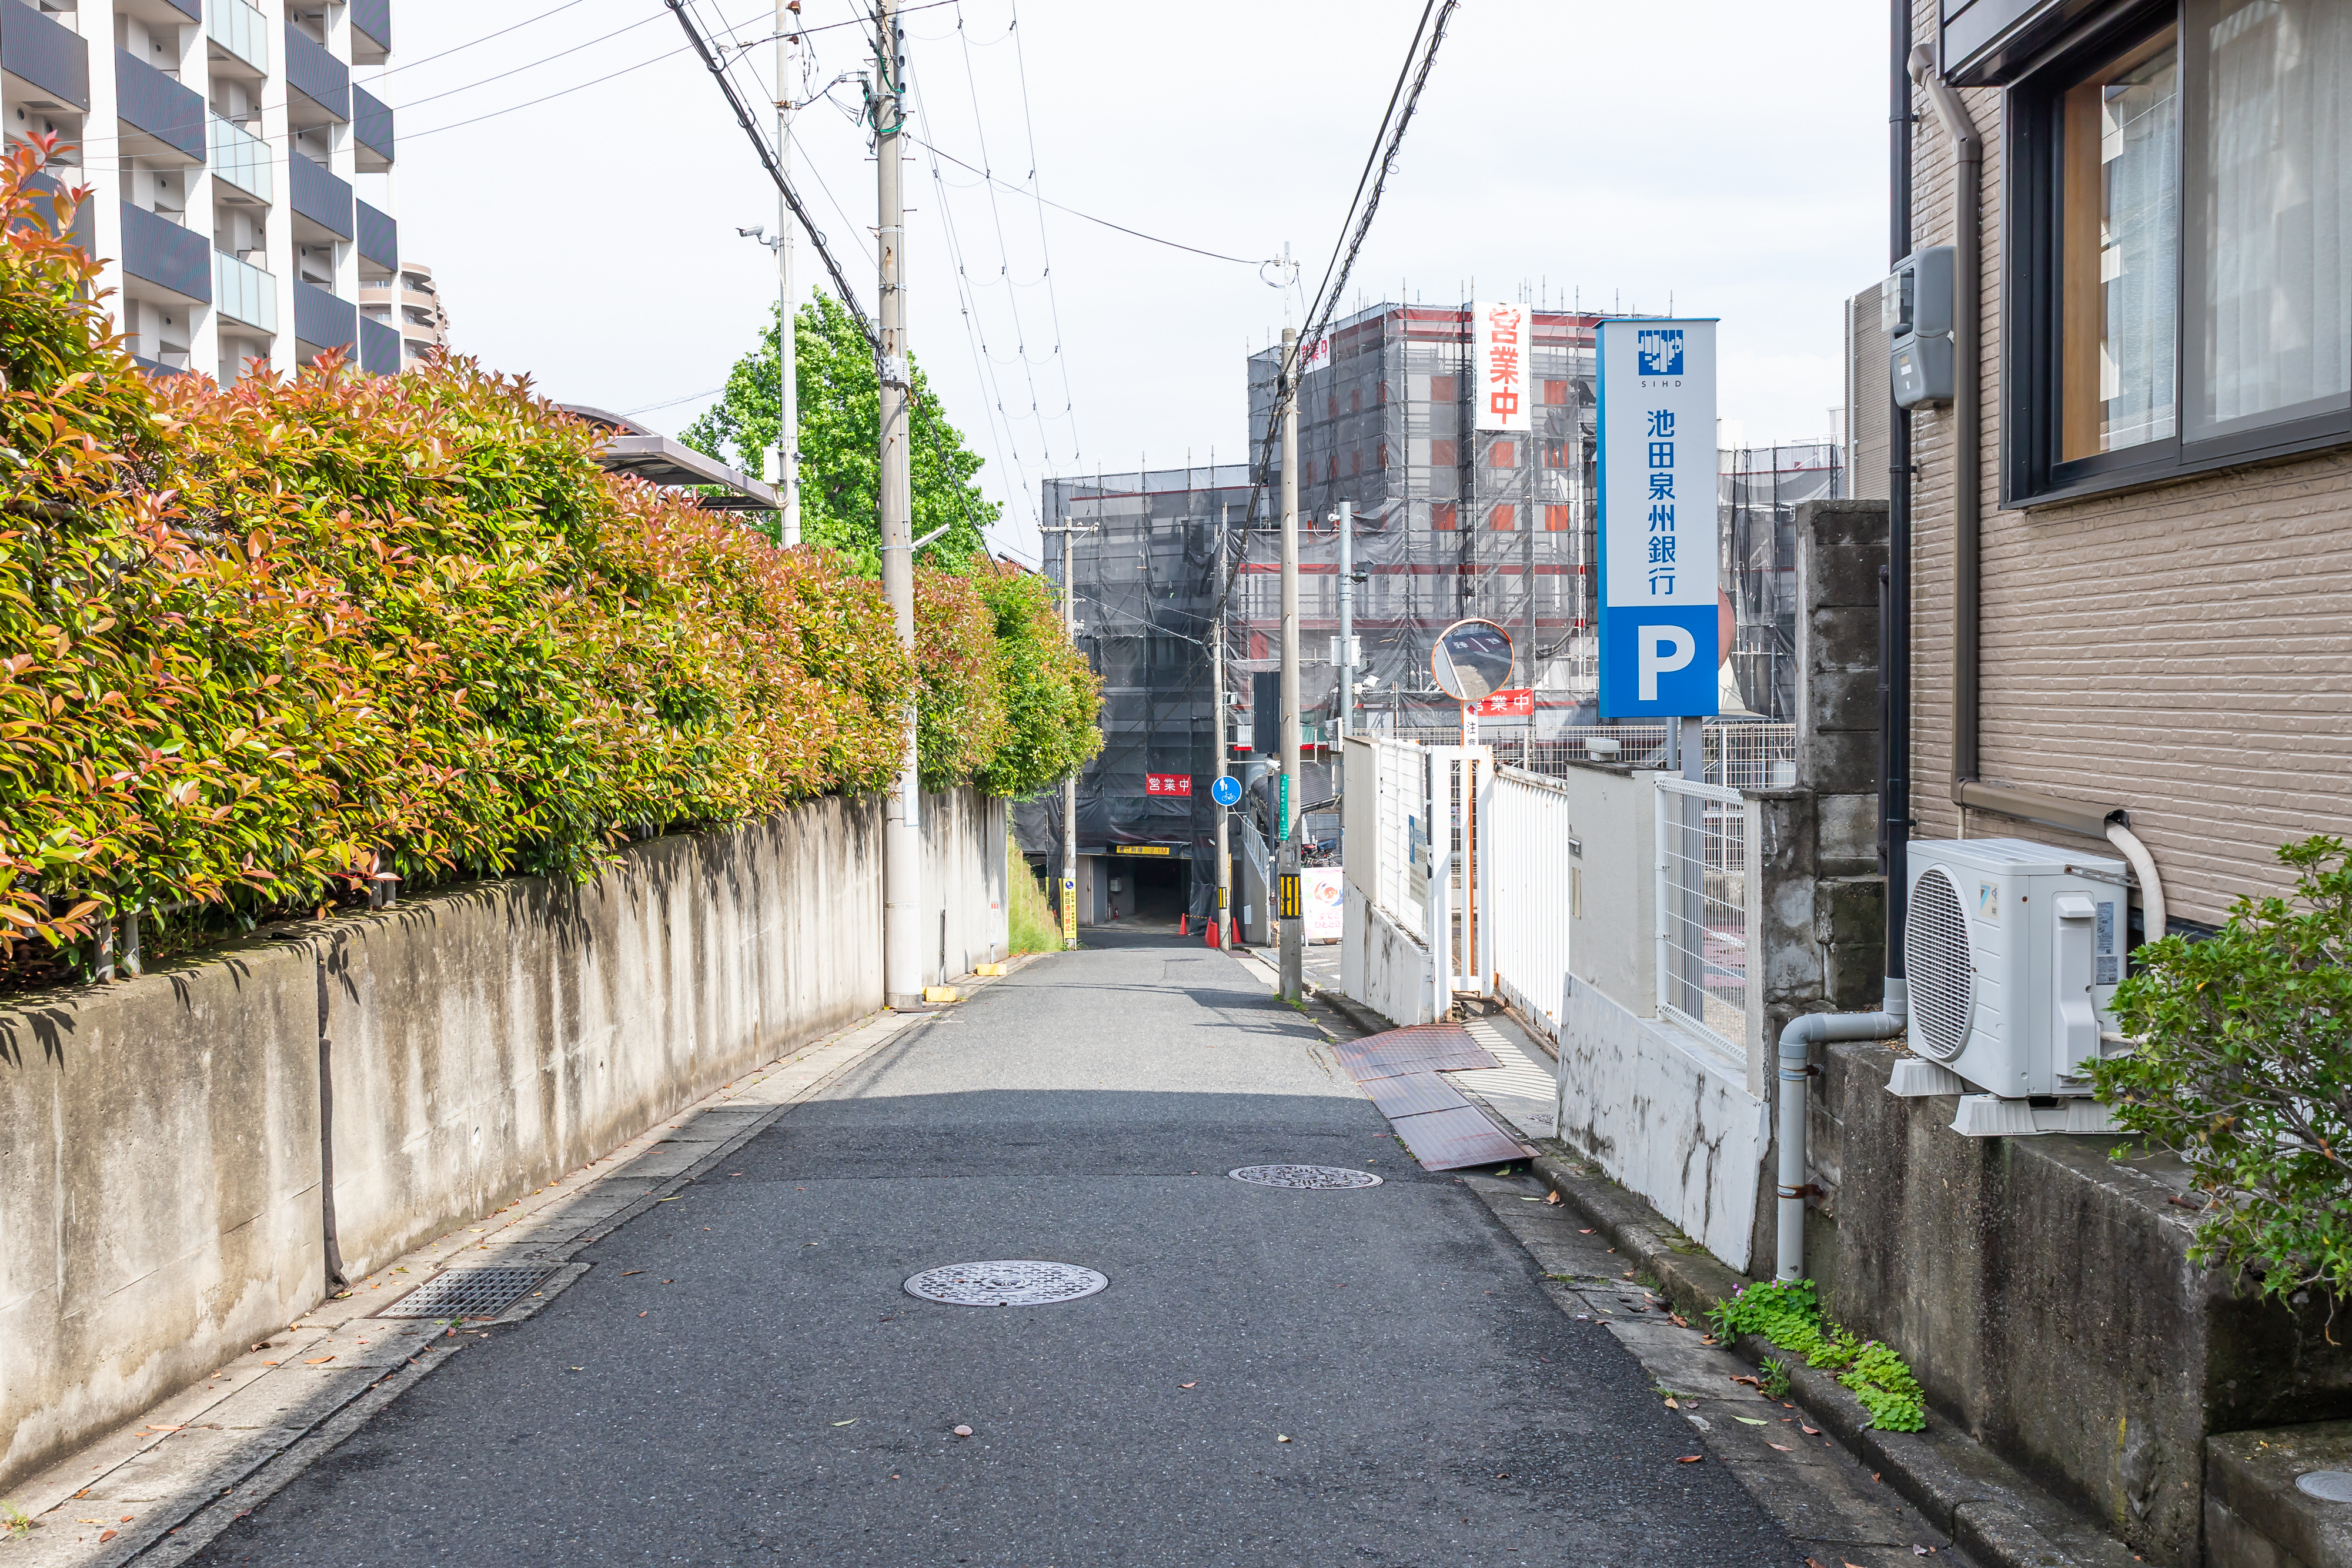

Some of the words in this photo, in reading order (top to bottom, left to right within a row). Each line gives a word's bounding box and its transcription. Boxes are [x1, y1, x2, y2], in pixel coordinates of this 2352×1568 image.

[1489, 307, 1521, 424] 営業中
[1647, 409, 1676, 595] 池田泉州銀行
[1638, 625, 1696, 701] P
[1148, 777, 1189, 792] 営業中
